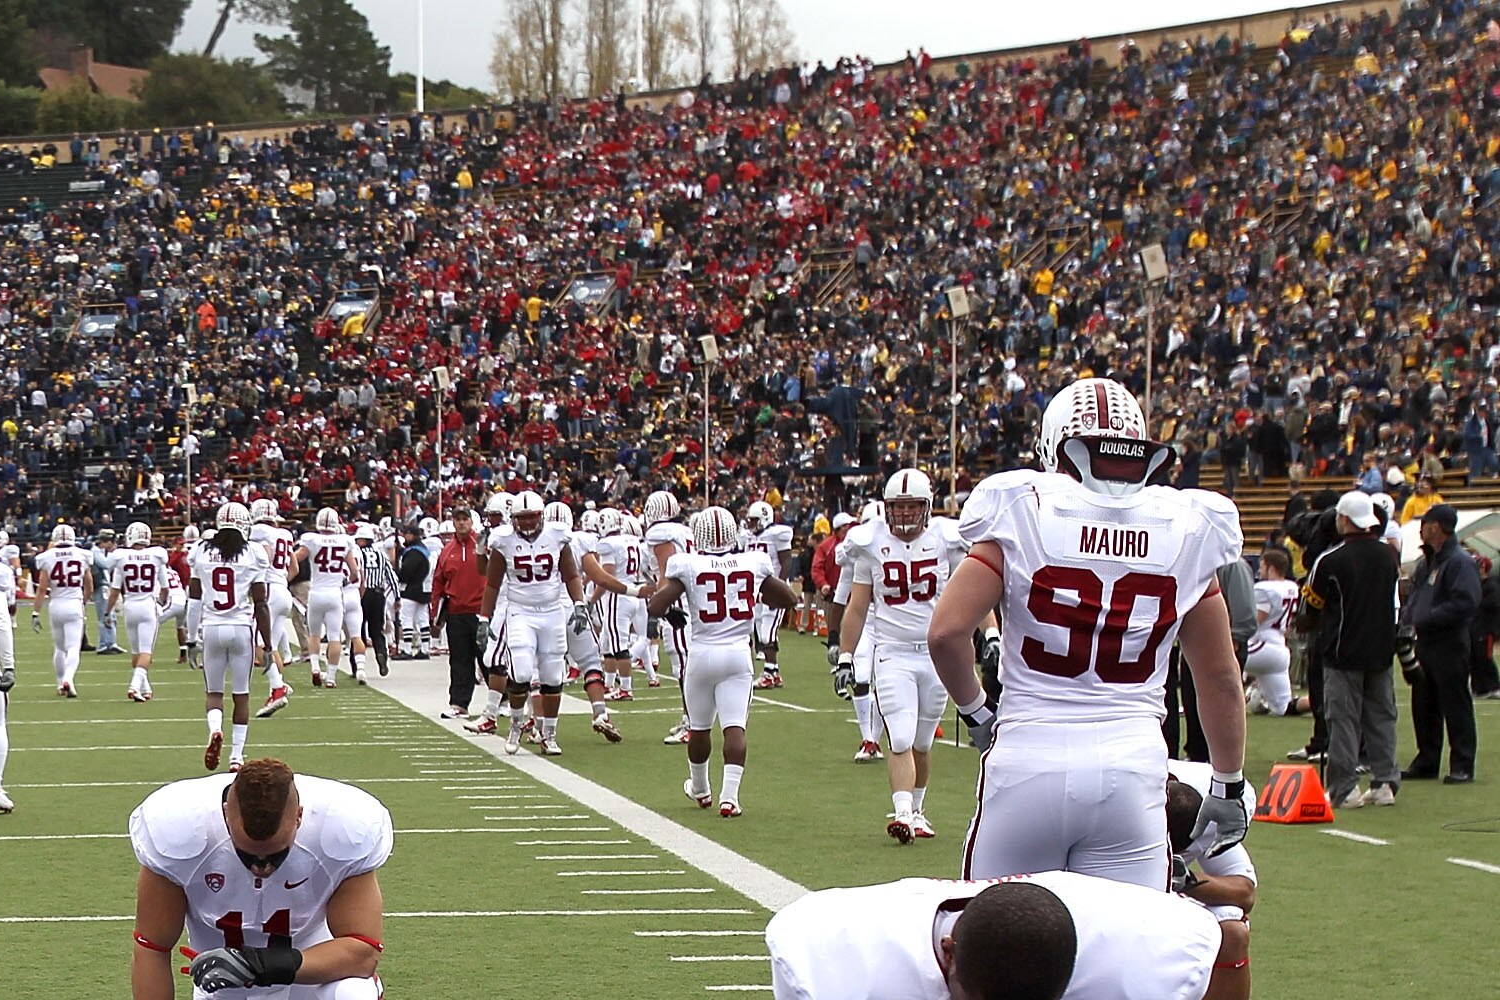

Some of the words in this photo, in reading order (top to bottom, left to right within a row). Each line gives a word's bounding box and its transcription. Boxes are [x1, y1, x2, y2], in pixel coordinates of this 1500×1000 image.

[1111, 417, 1123, 429] 90
[1100, 441, 1145, 457] DOUGLAS
[1079, 526, 1149, 558] MAURO
[50, 560, 83, 588] 42
[314, 546, 346, 574] 45
[366, 553, 378, 568] R
[514, 553, 555, 584] 53
[626, 546, 641, 576] 61
[123, 563, 156, 593] 29
[212, 566, 236, 611] 9
[882, 557, 938, 606] 95
[695, 570, 756, 624] 33
[1020, 564, 1178, 684] 90
[1256, 769, 1303, 817] 10
